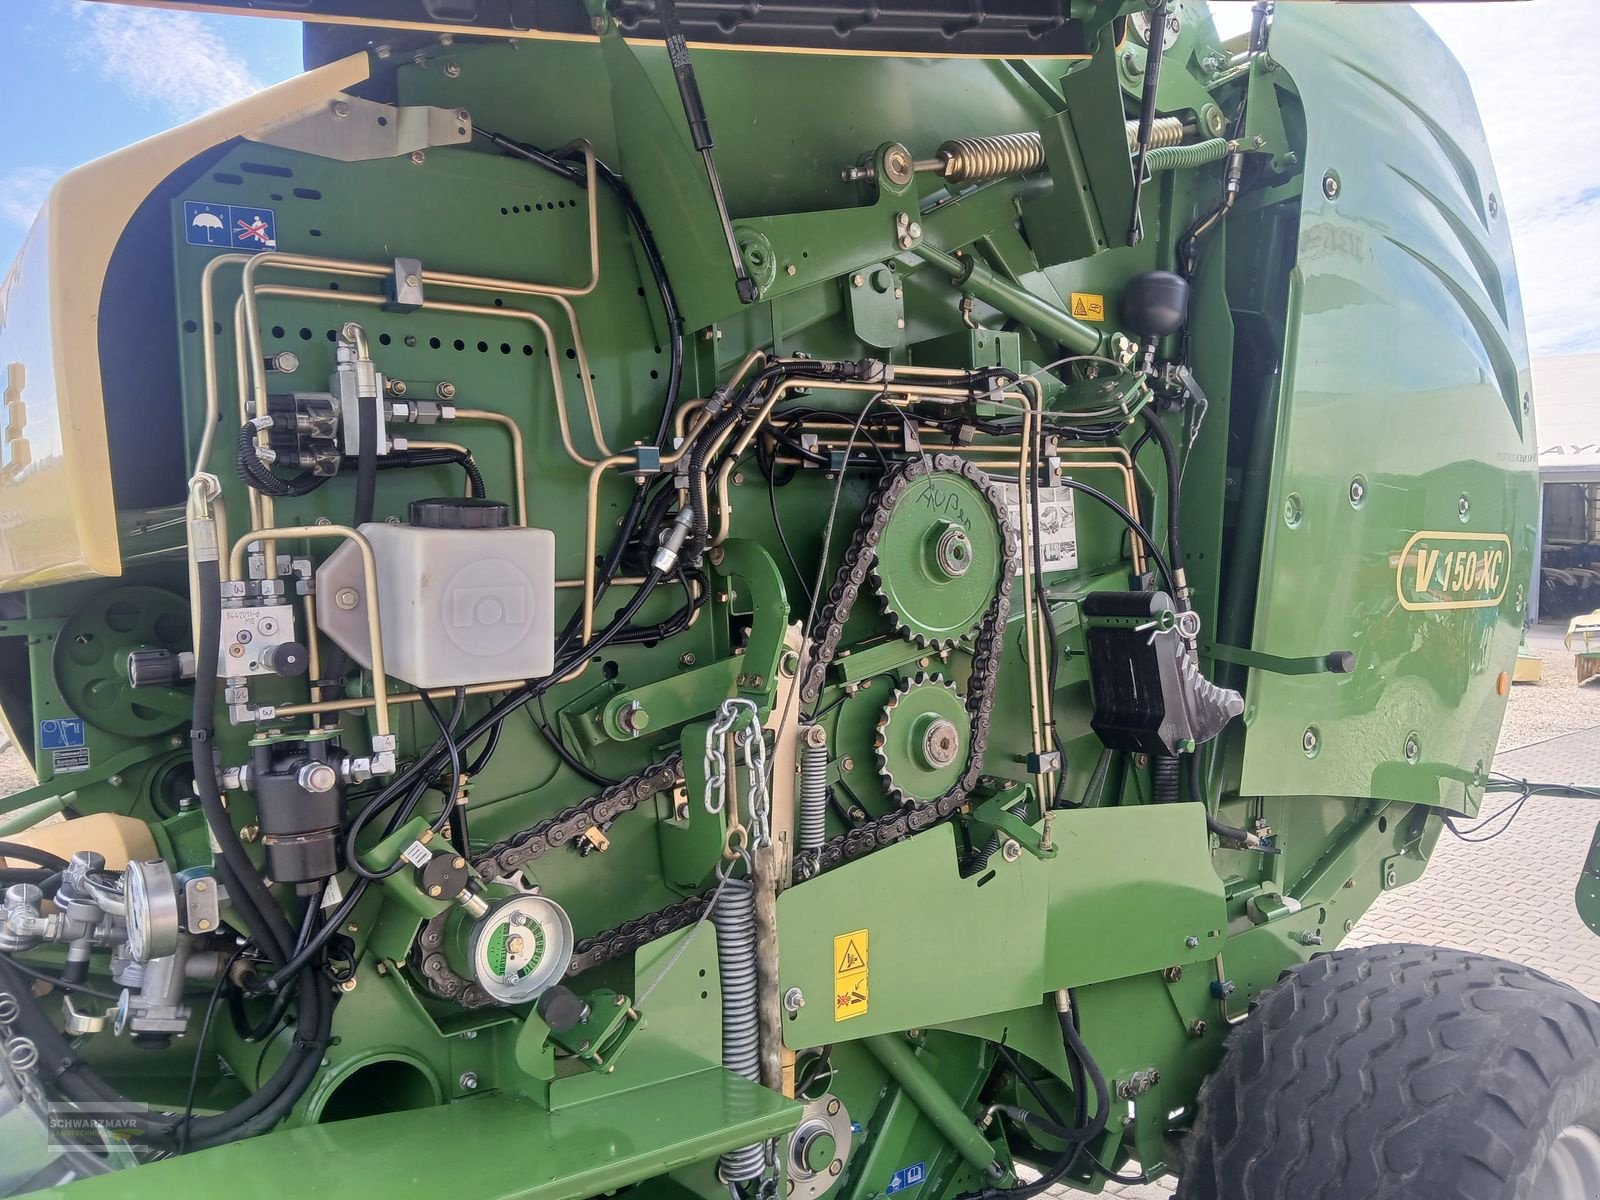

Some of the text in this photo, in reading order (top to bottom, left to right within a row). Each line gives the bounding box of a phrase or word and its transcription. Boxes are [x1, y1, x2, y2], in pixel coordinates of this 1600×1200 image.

[1415, 549, 1502, 593] V 150 XC
